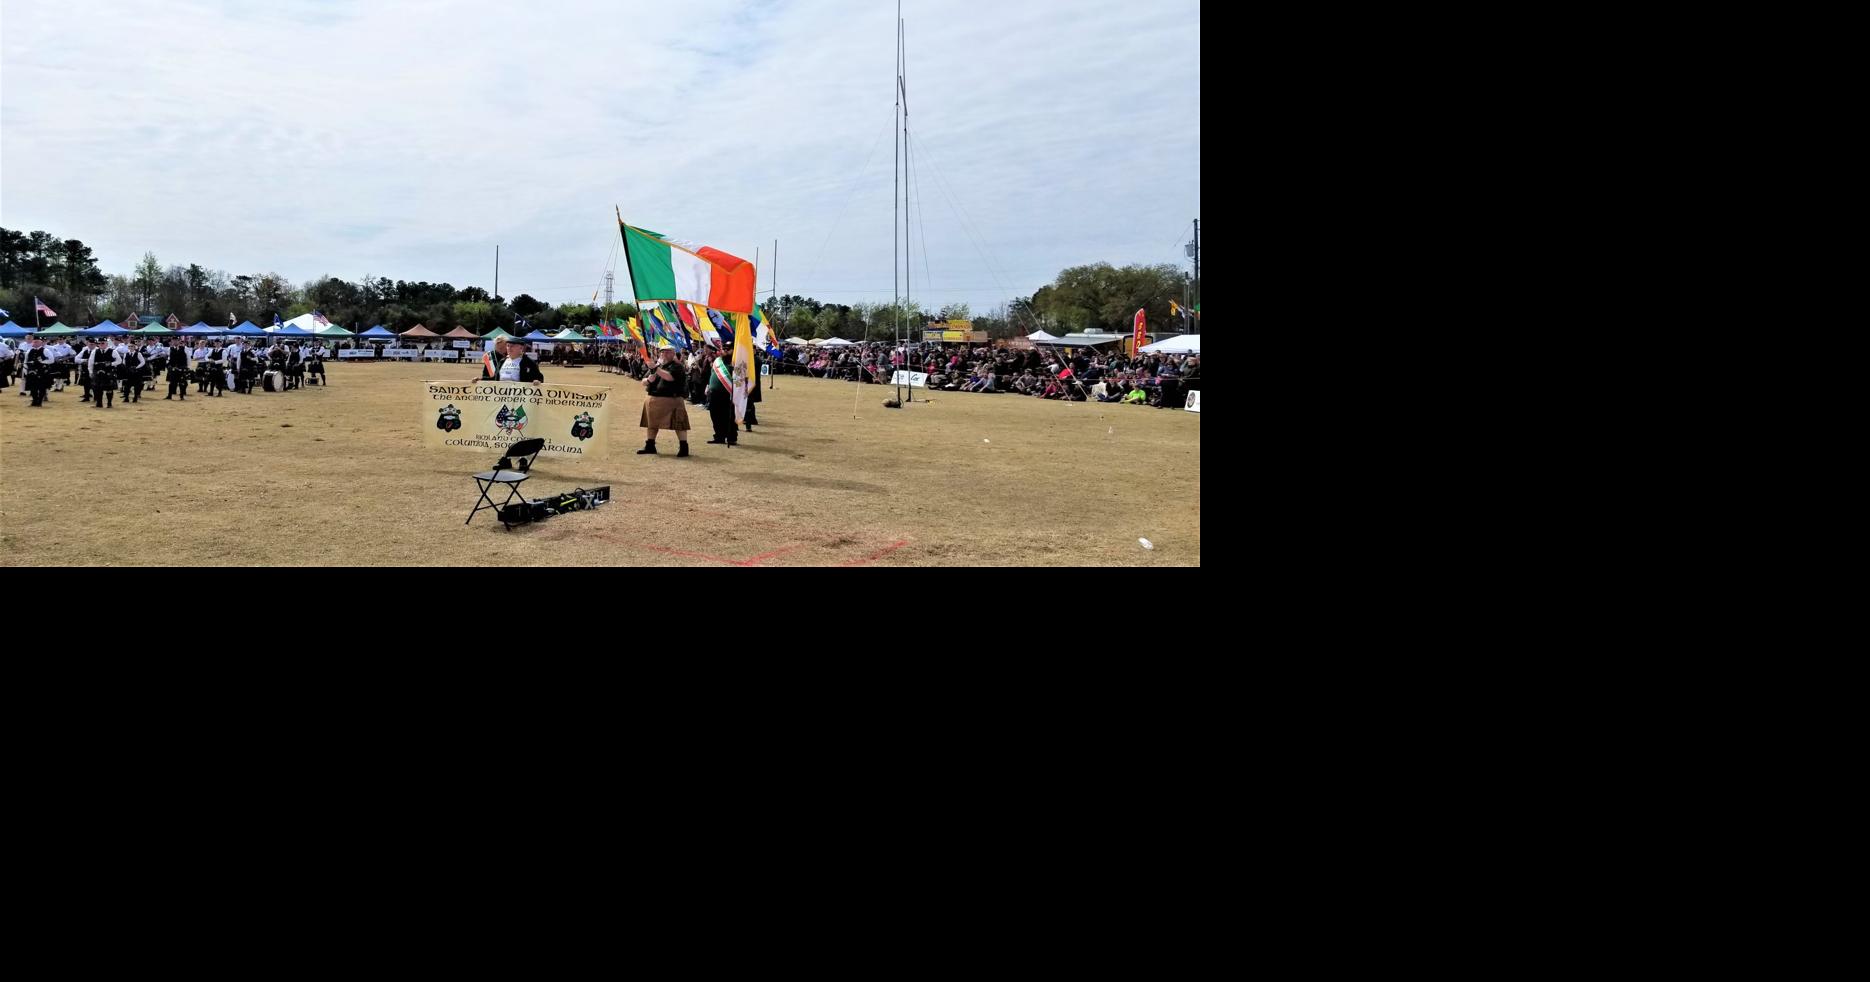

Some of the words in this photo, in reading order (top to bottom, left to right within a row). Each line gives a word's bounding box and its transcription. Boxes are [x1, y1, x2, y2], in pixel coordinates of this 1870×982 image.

[429, 385, 472, 395] SAINT
[475, 385, 543, 397] COLUMBA
[546, 389, 608, 401] DIVISION
[529, 397, 543, 406] OF
[545, 398, 603, 408] HIBERNIANS
[541, 444, 582, 454] AROLINA
